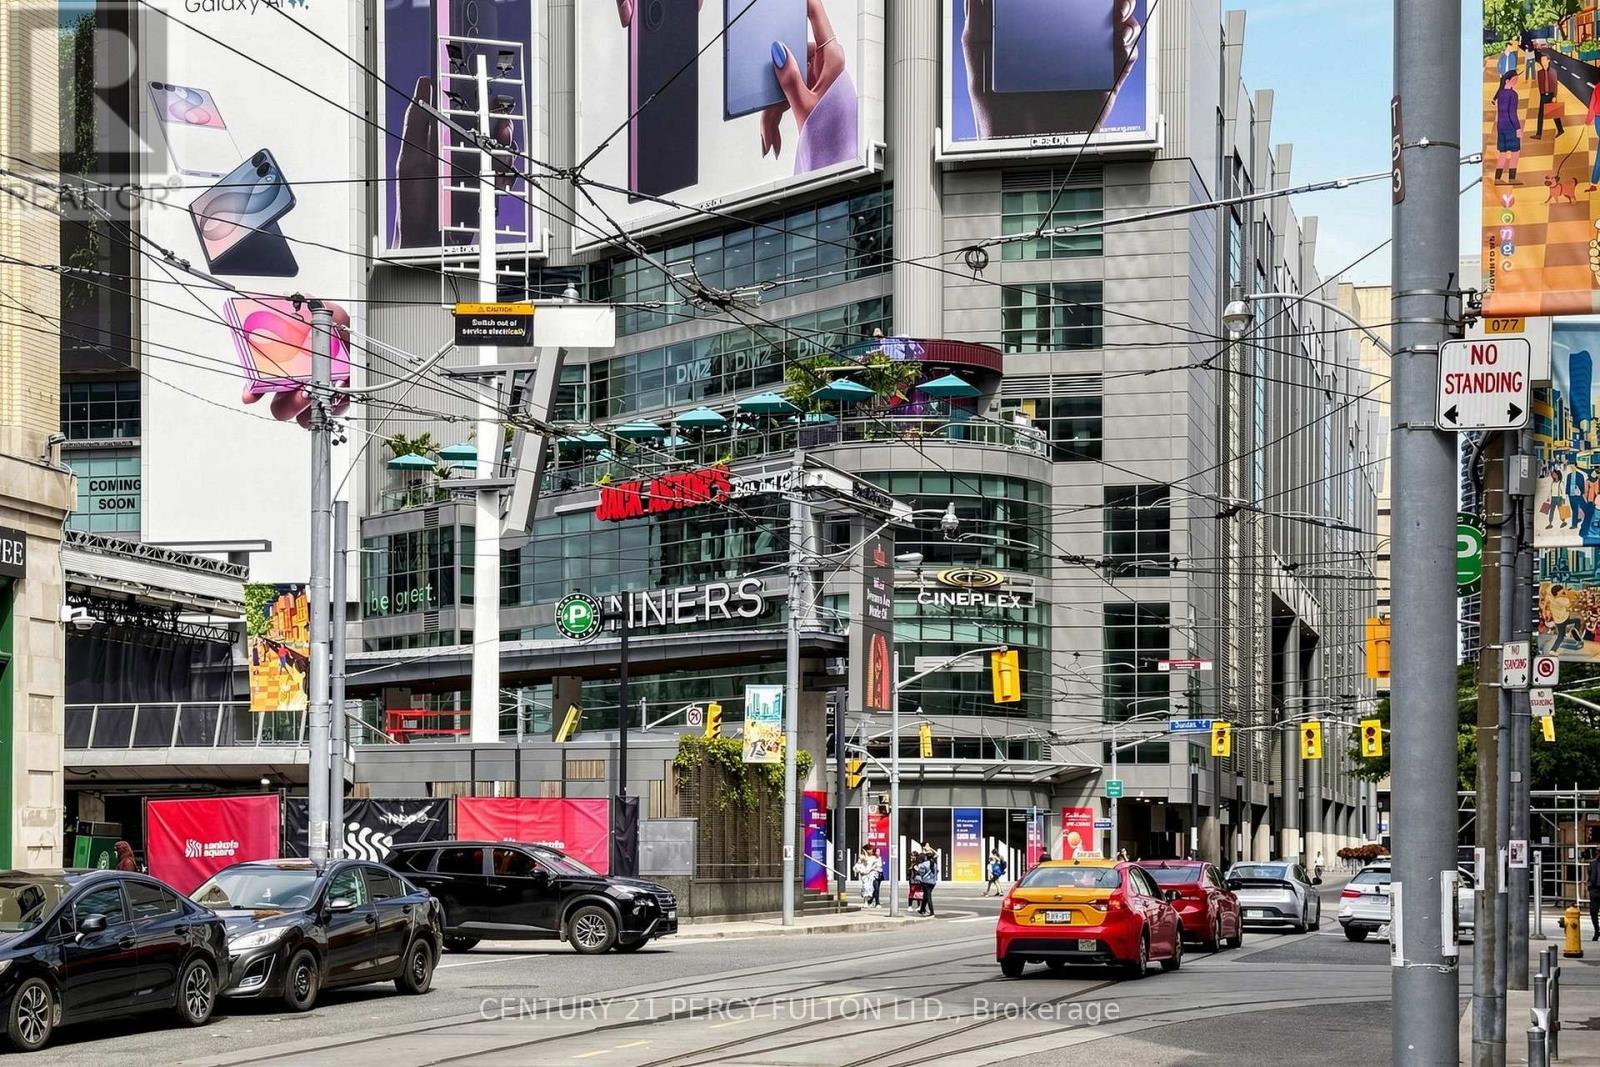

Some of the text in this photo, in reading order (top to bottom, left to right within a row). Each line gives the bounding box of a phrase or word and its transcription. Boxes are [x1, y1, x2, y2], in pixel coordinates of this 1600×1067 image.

[472, 318, 495, 326] Switch
[1492, 318, 1520, 332] 077
[488, 327, 526, 337] electrically
[797, 332, 837, 357] DMZ
[735, 345, 772, 371] DMZ
[1471, 343, 1498, 366] NO
[676, 358, 712, 385] DMZ
[1444, 371, 1523, 395] STANDING
[89, 479, 141, 493] COMING
[98, 497, 136, 510] SOON
[0, 538, 24, 566] EE
[371, 582, 437, 613] be great.
[917, 591, 1021, 609] CINEPLEX
[569, 605, 588, 624] P
[1511, 645, 1520, 655] NO
